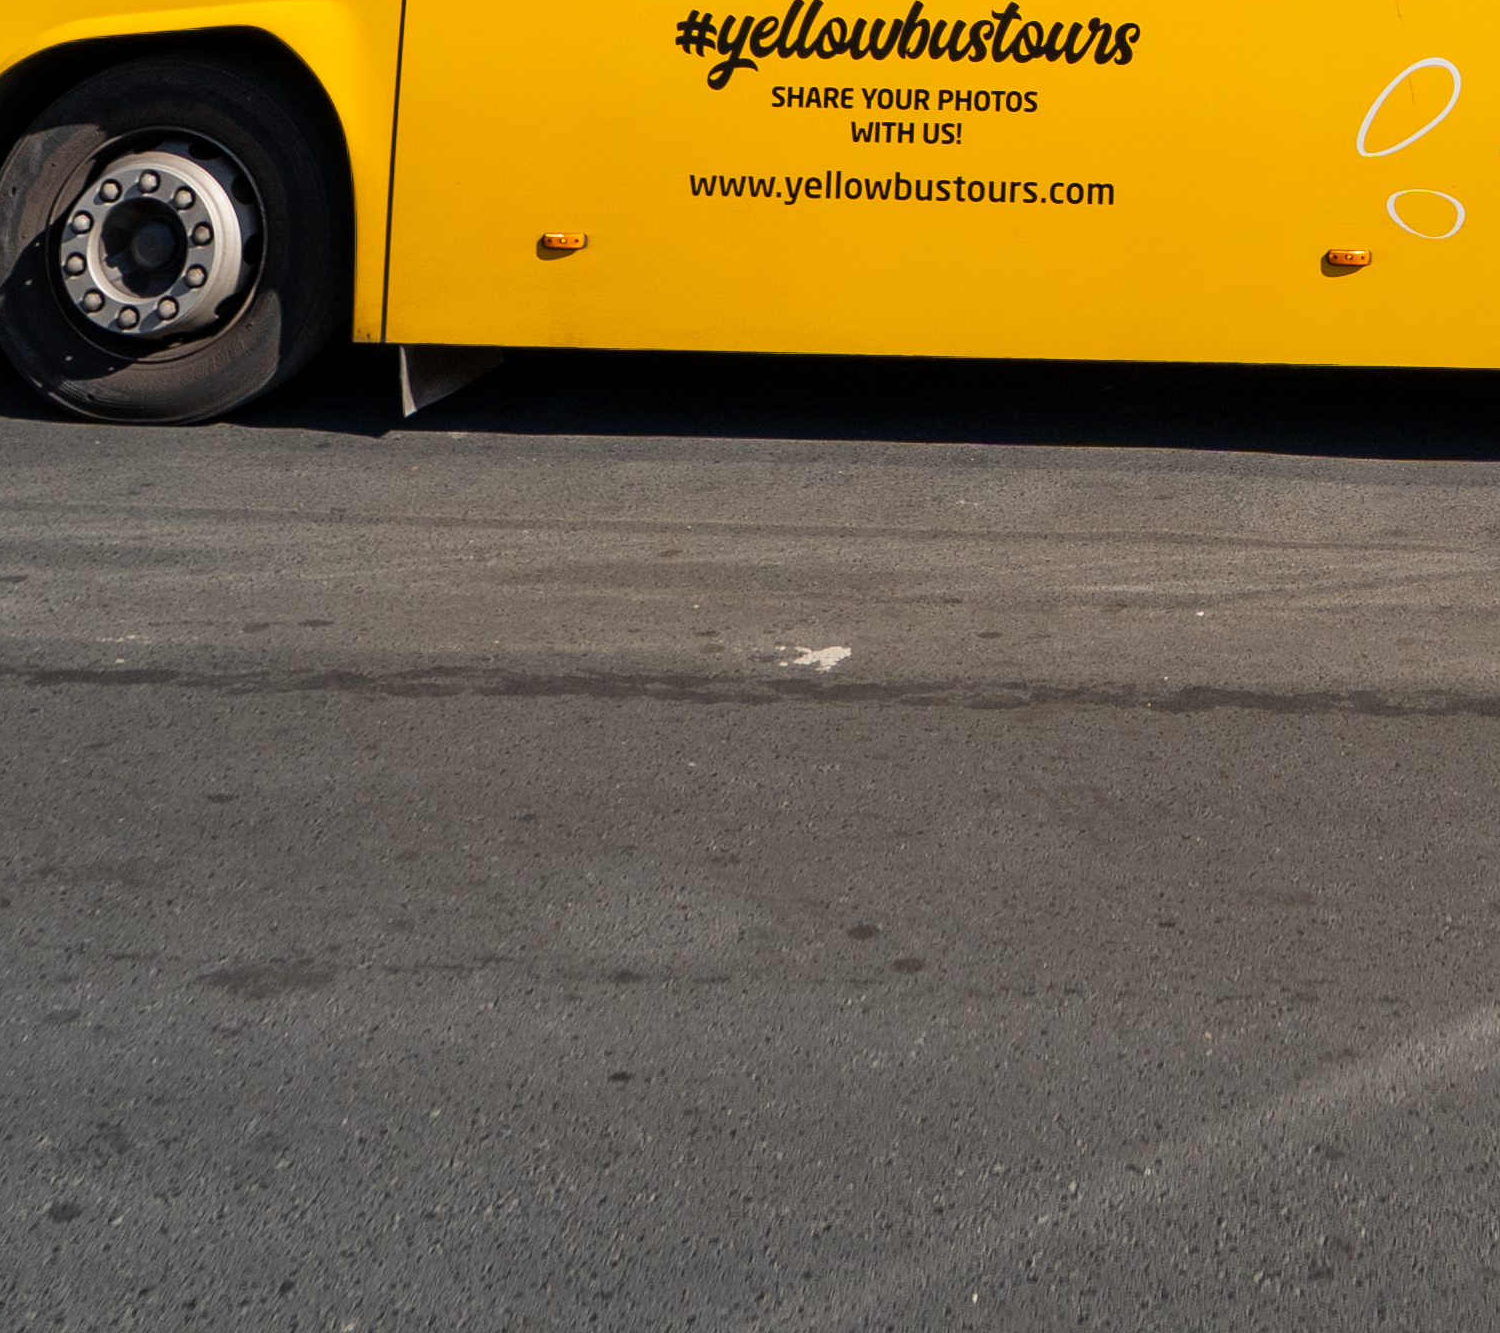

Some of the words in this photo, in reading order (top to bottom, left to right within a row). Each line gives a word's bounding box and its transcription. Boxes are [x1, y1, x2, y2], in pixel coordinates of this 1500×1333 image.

[771, 86, 854, 110] SHARE
[861, 87, 930, 111] YOUR
[938, 89, 1038, 113] PHOTOS
[851, 121, 915, 144] WITH
[923, 122, 962, 145] US!
[689, 170, 1115, 207] www.yellowbustours.com
